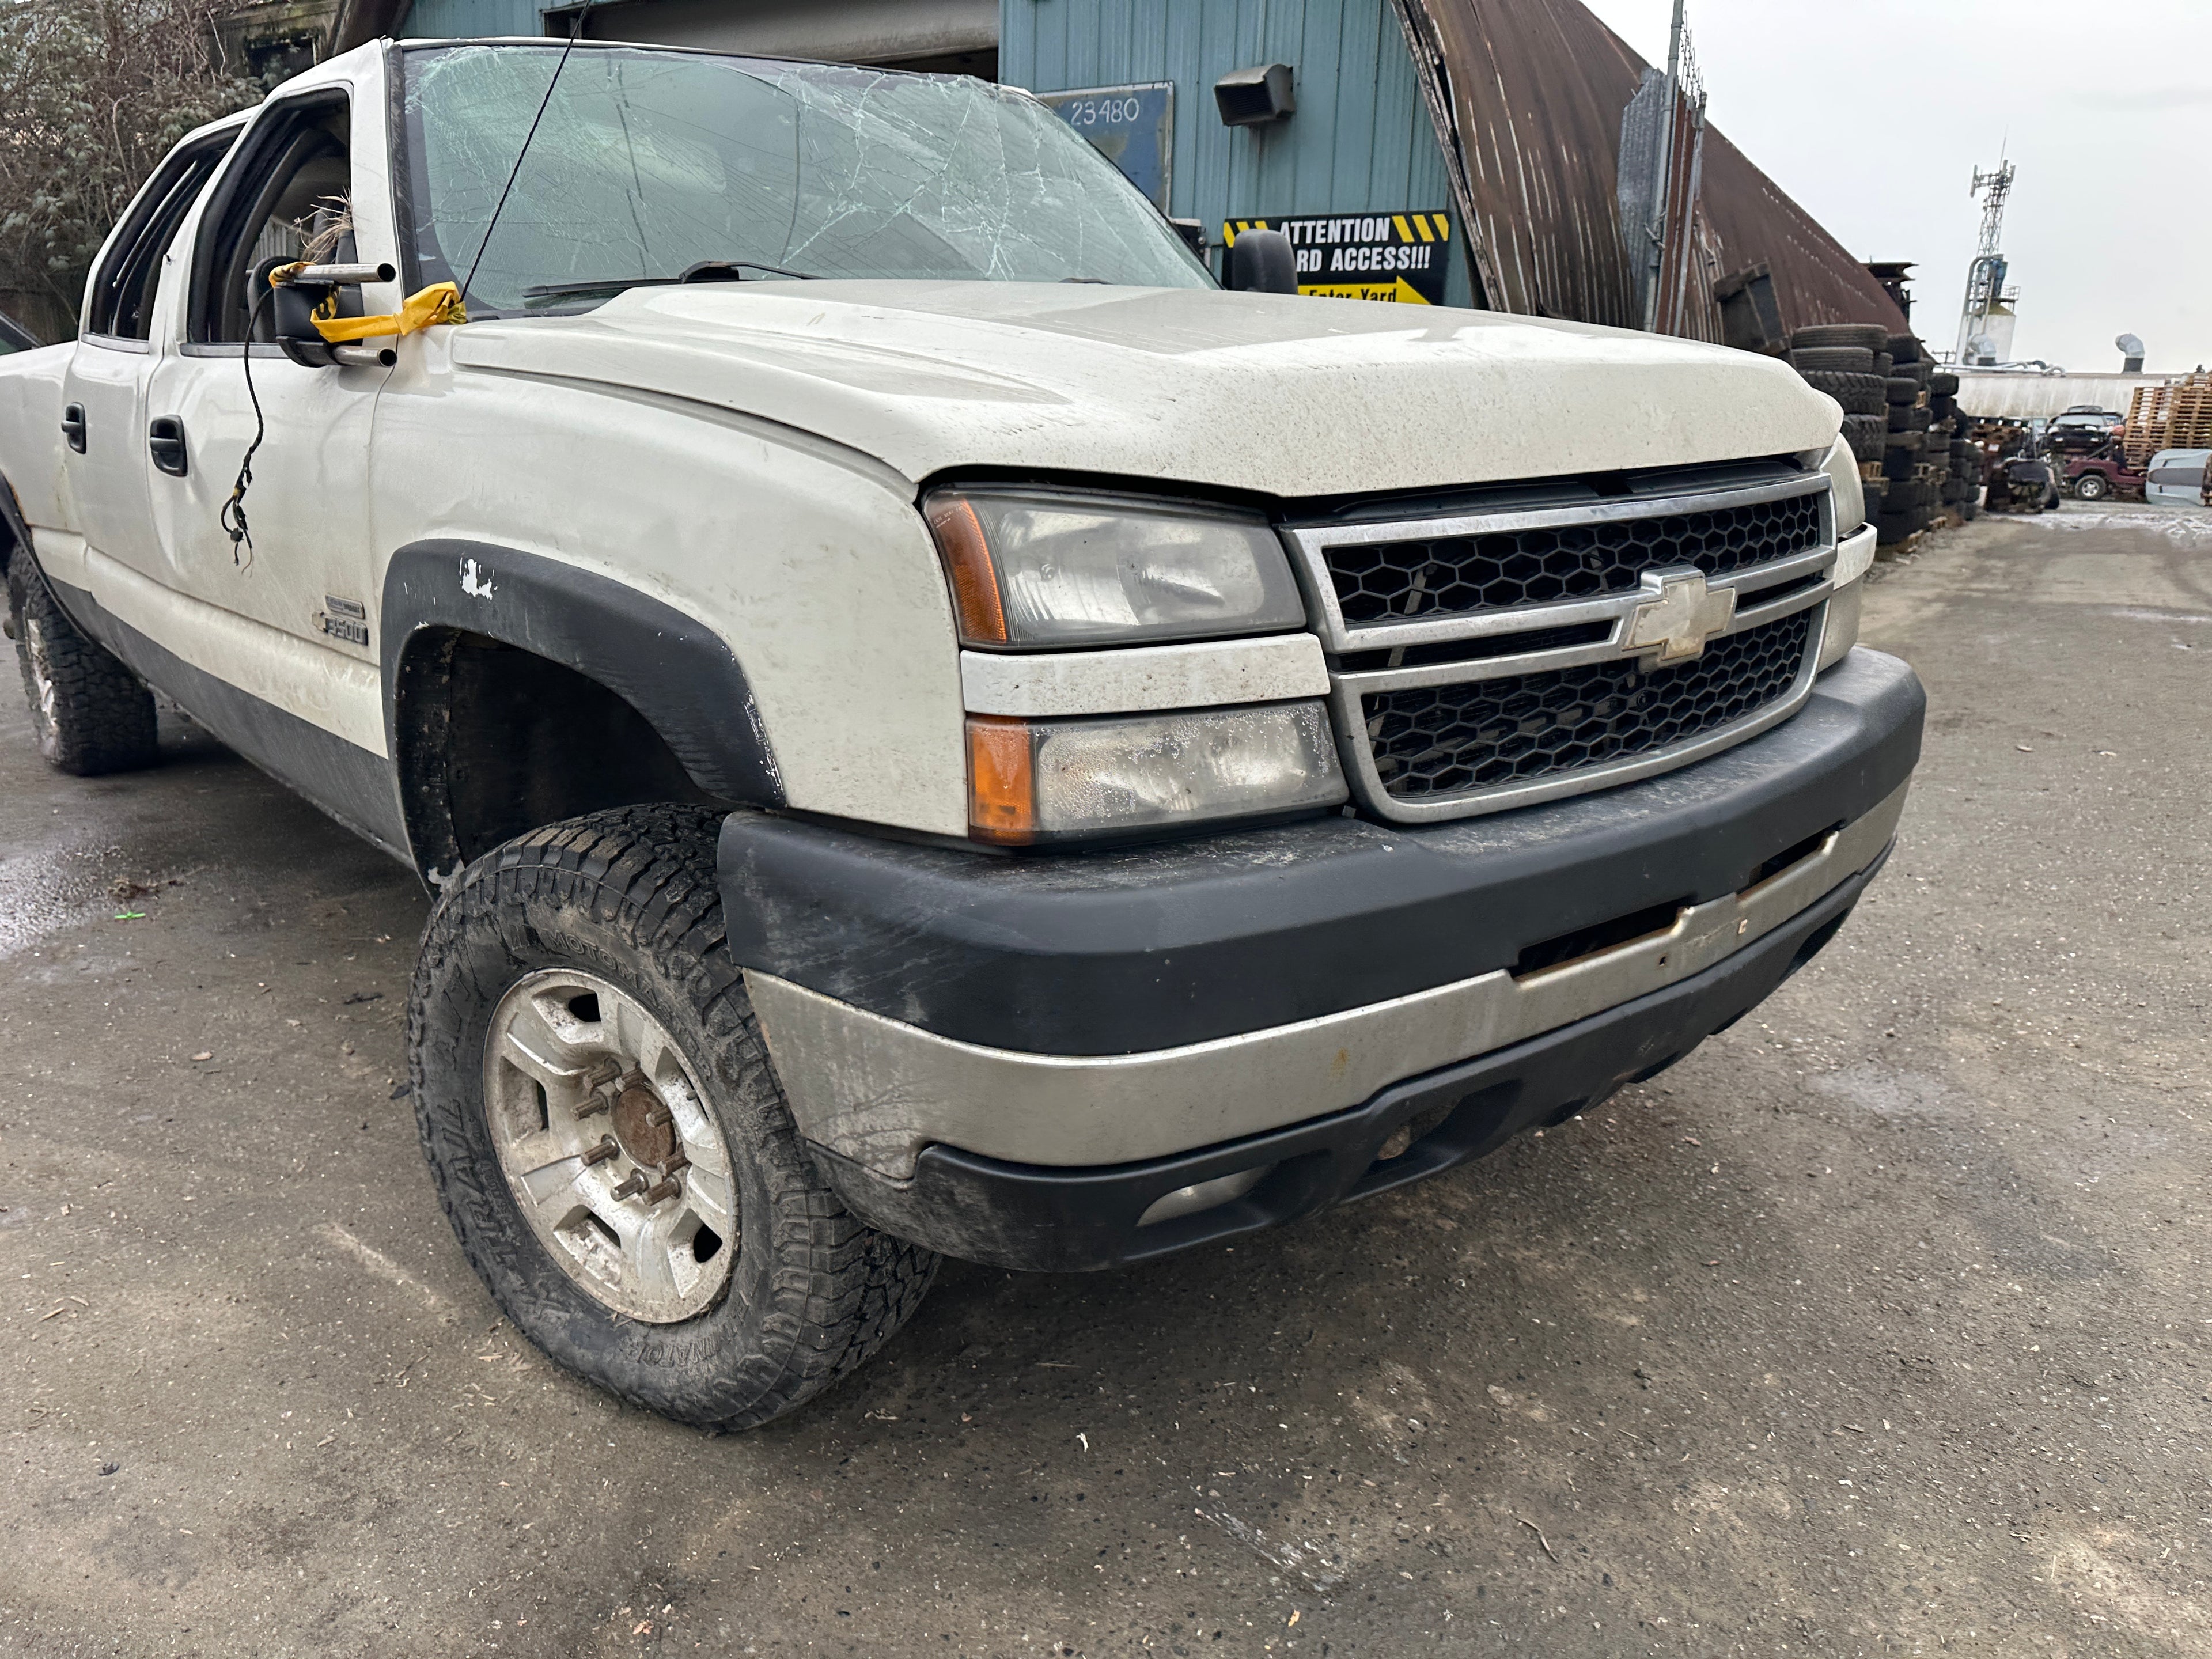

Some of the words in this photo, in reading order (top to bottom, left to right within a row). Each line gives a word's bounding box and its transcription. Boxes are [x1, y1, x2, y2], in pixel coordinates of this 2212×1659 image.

[1071, 97, 1139, 126] 23480
[1279, 218, 1390, 244] ATTENTION
[1296, 249, 1323, 272] RD
[1330, 245, 1431, 271] ACCESS!!!
